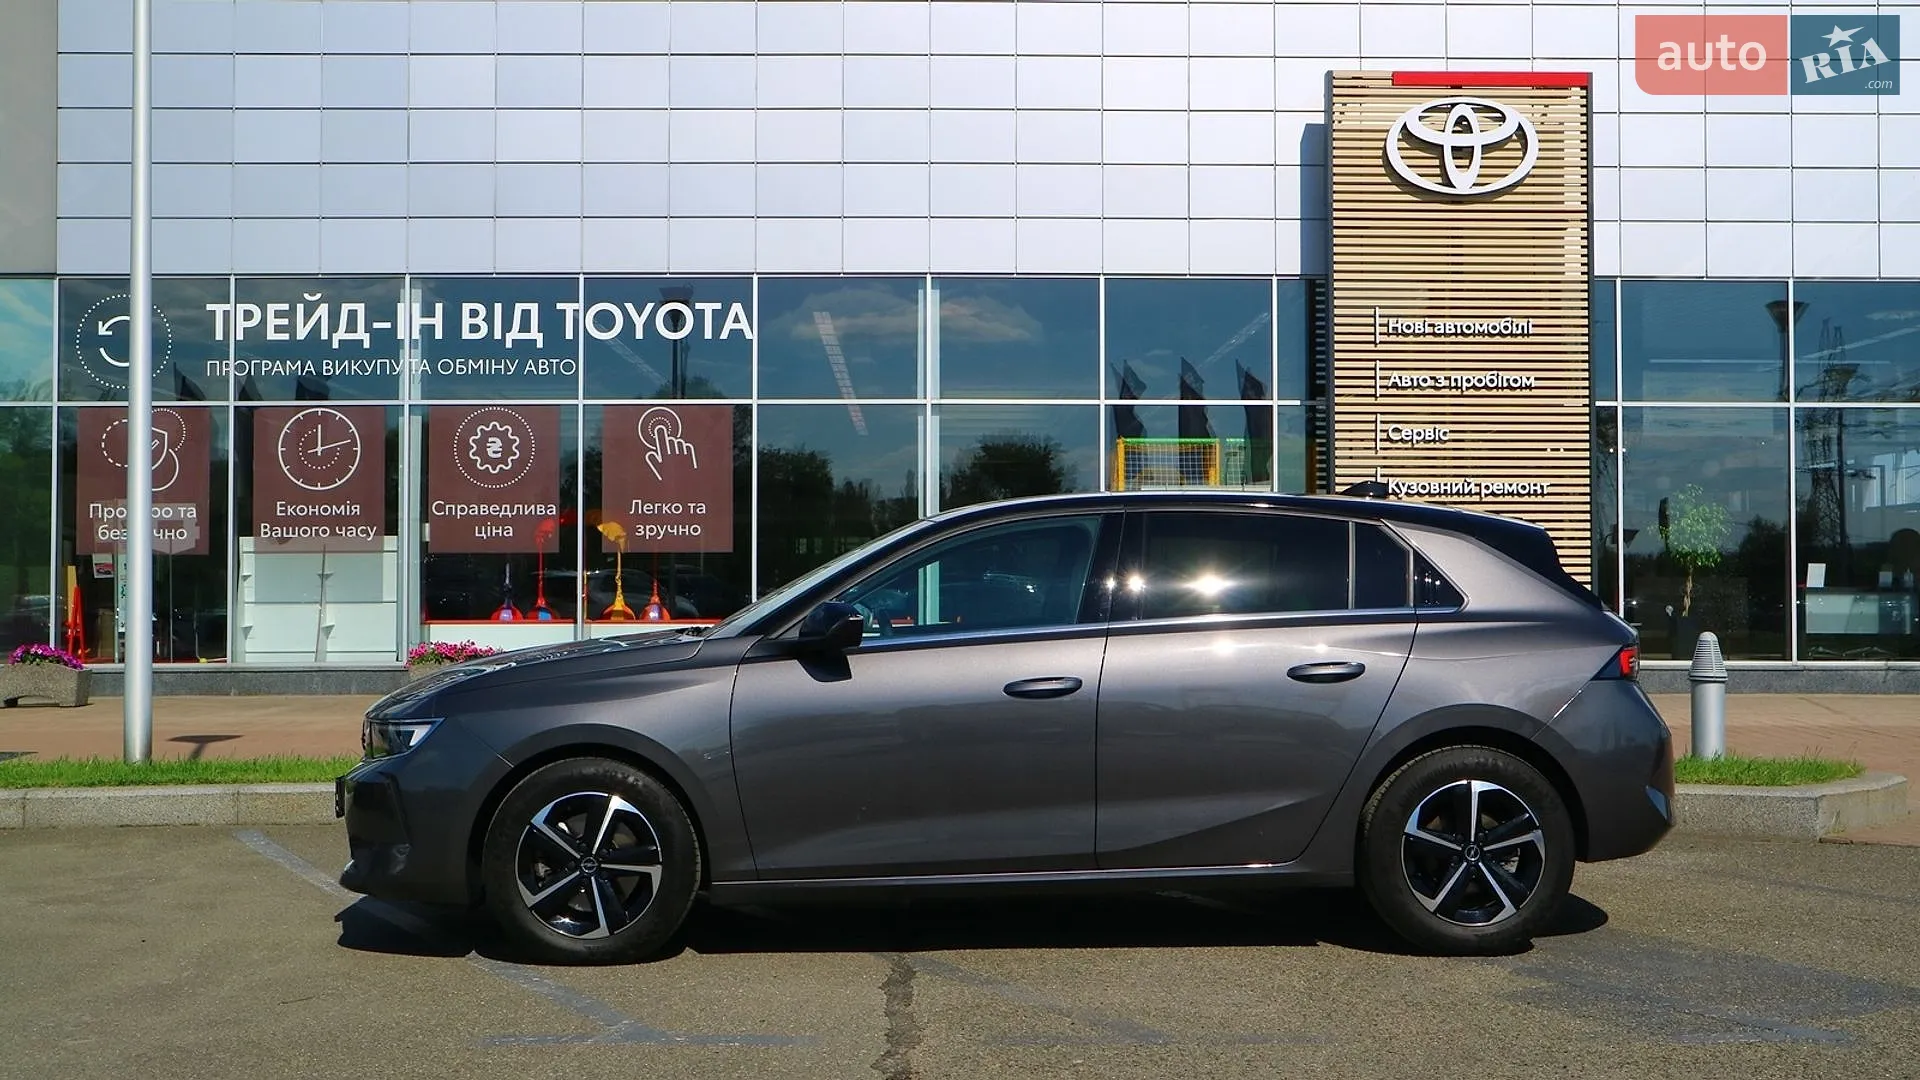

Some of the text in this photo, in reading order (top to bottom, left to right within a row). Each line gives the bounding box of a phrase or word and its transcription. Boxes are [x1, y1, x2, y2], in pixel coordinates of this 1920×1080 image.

[206, 292, 754, 349] ТРЕЙД-ІН ВІД TOYOTA
[1387, 316, 1534, 337] Нові автомобілі
[206, 357, 577, 377] ПРОГРАМА ВИКУПУ ТА ОБМІНУ АВТО
[1387, 370, 1536, 392] Авто з пробігом
[1388, 424, 1450, 445] Сервіс
[1387, 477, 1551, 499] Кузовний ремонт
[89, 503, 197, 522] Проо та
[275, 500, 361, 516] Економія
[432, 500, 557, 519] Справедлива
[629, 499, 706, 515] Легко та
[98, 524, 188, 540] безчно
[260, 523, 377, 541] Вашого часу
[474, 522, 514, 540] ціна
[635, 523, 702, 540] зручно
